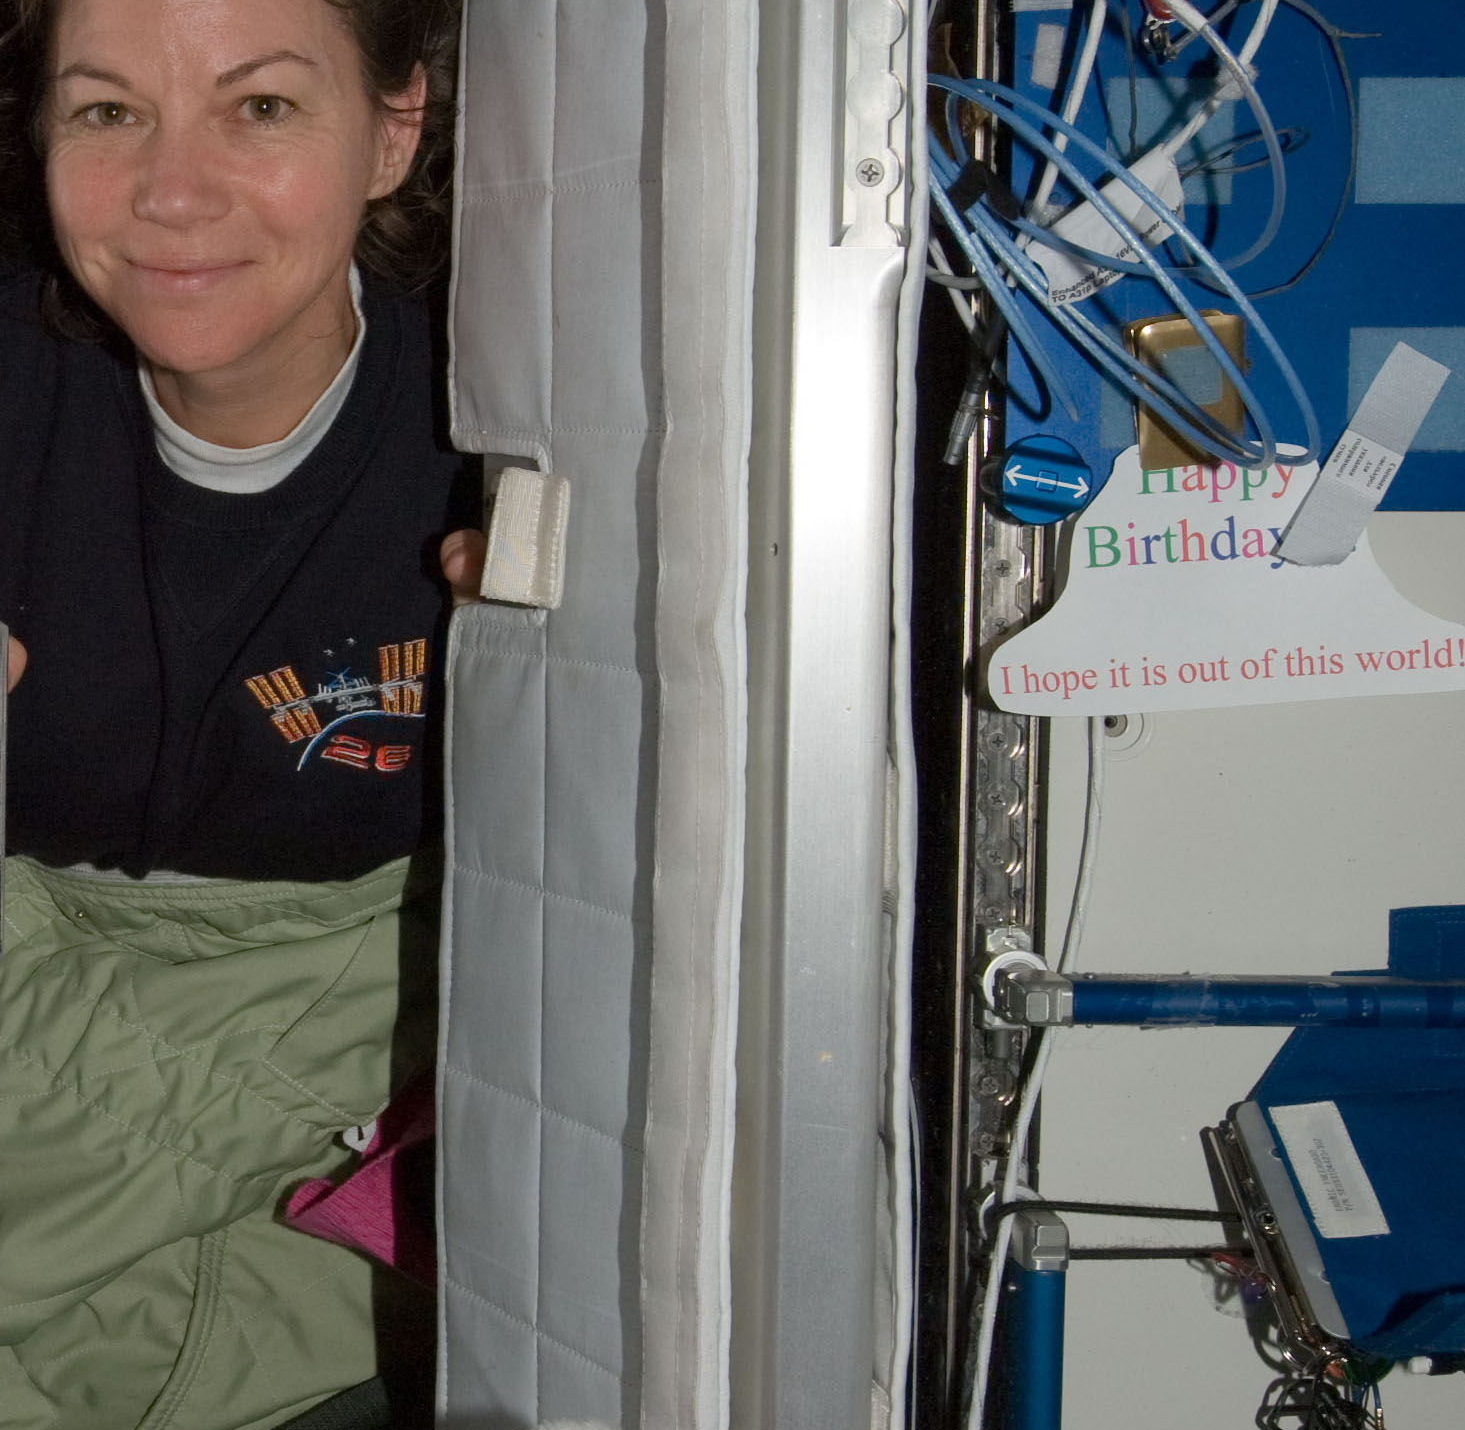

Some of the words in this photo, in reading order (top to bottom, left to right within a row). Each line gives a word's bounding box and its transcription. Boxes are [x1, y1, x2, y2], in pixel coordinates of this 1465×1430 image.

[1051, 294, 1067, 304] TO
[1137, 460, 1295, 504] Happy
[1083, 515, 1289, 570] Birthday
[1000, 666, 1014, 696] I
[1022, 665, 1100, 701] hope
[1109, 658, 1132, 689] it
[1141, 656, 1168, 687] is
[1178, 655, 1231, 685] out
[1240, 648, 1279, 678] of
[1284, 644, 1345, 678] this
[1355, 637, 1465, 673] world!
[321, 734, 415, 773] 26
